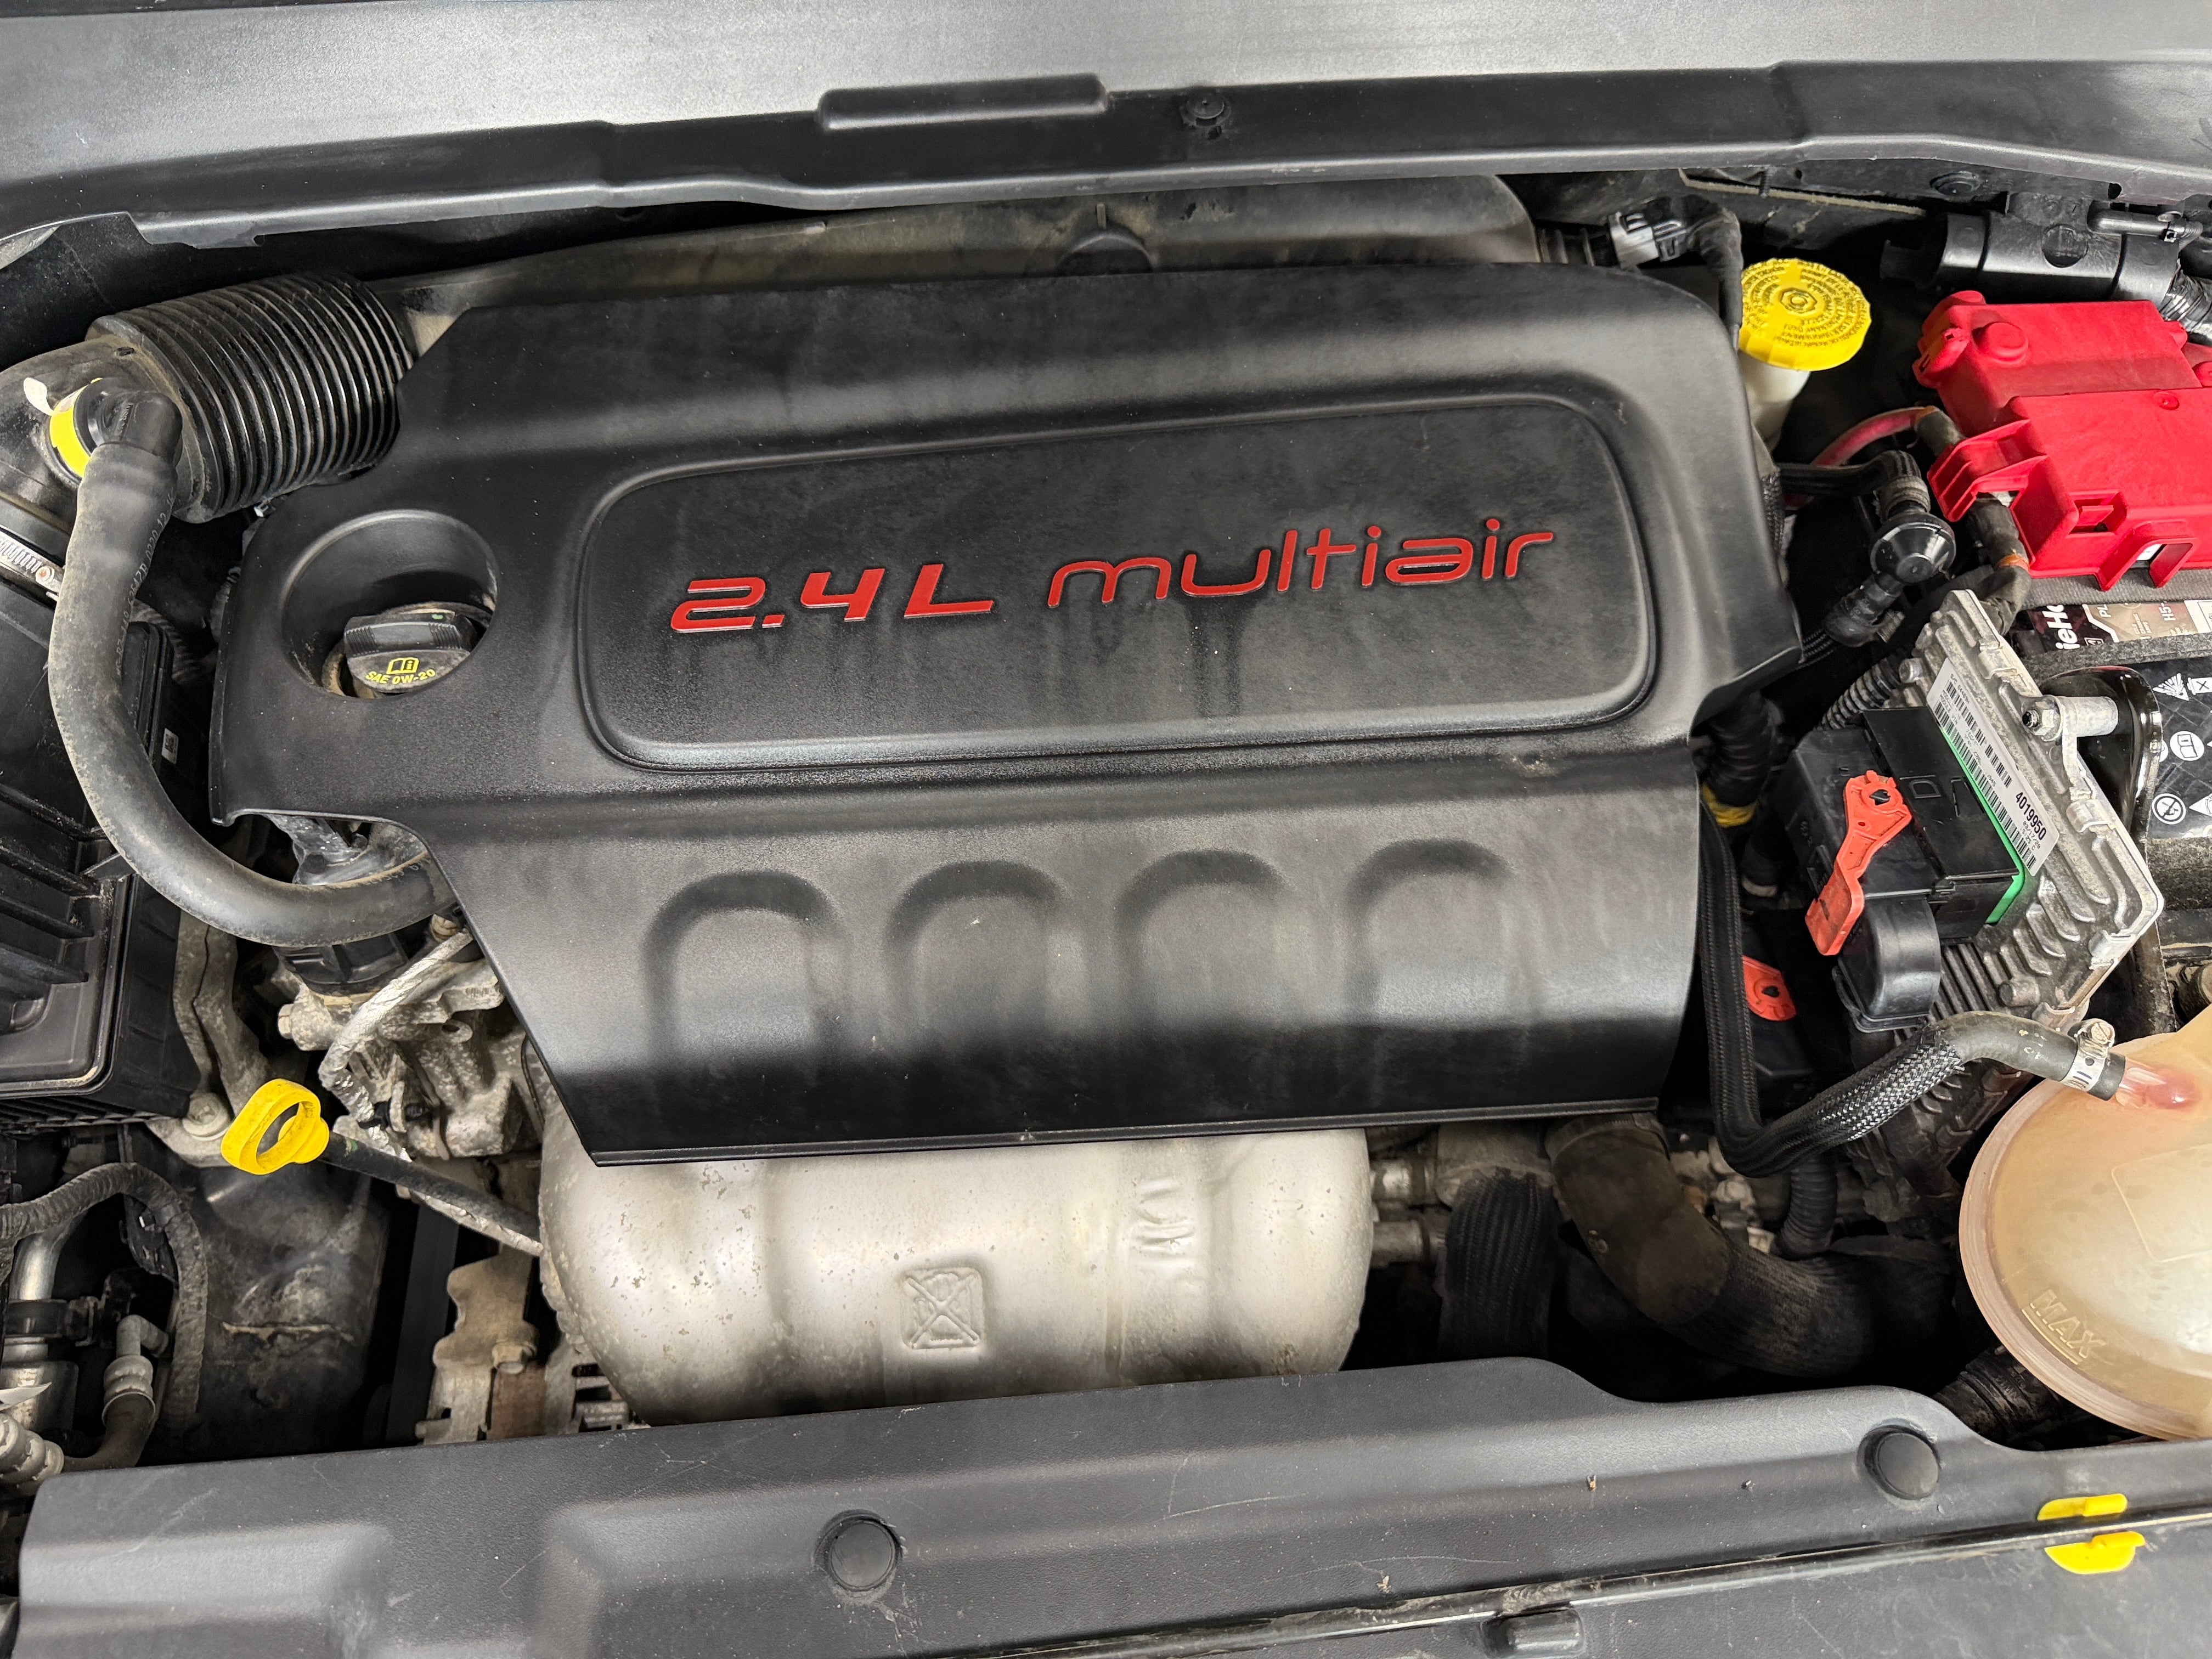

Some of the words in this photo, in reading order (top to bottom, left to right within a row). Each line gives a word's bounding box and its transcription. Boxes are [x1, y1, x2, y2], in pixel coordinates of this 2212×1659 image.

[1048, 518, 1553, 607] multiair
[2158, 602, 2176, 622] H5-
[365, 671, 390, 684] SAE
[2016, 792, 2047, 840] 4019950
[2030, 1289, 2106, 1358] MAX
